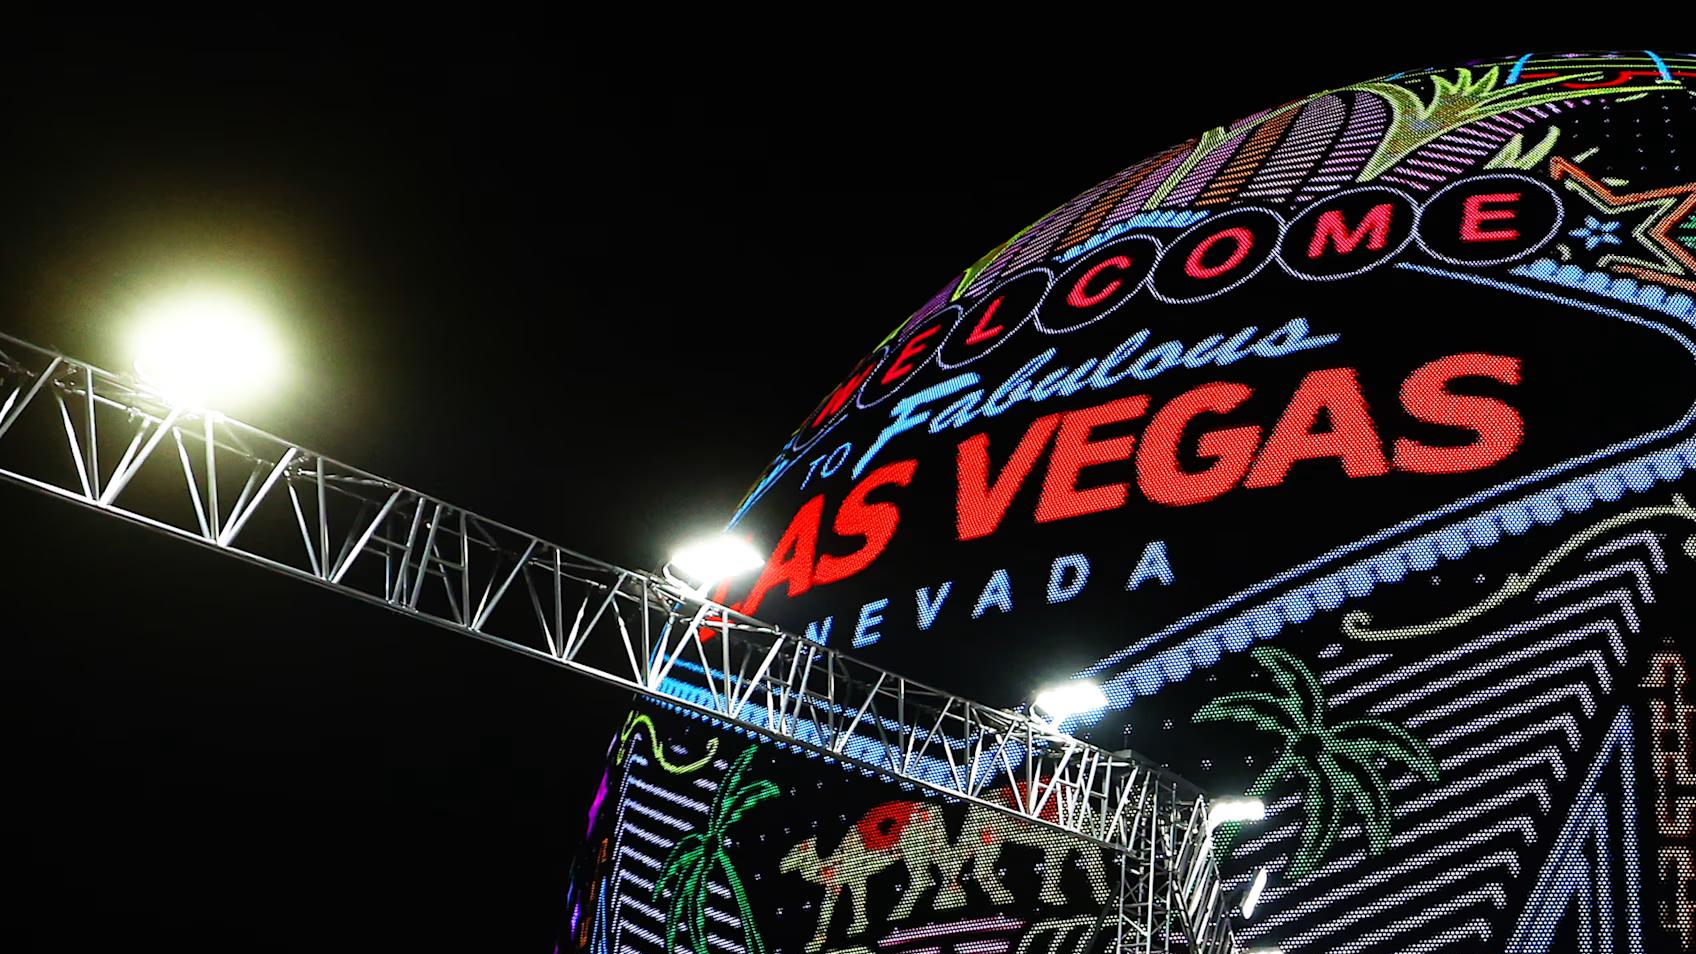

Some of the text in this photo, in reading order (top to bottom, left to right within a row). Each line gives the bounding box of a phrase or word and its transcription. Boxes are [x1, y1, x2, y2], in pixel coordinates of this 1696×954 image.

[801, 316, 1341, 490] TO Fabulous
[956, 353, 1524, 541] VEGAS
[800, 540, 1175, 662] NEVADA
